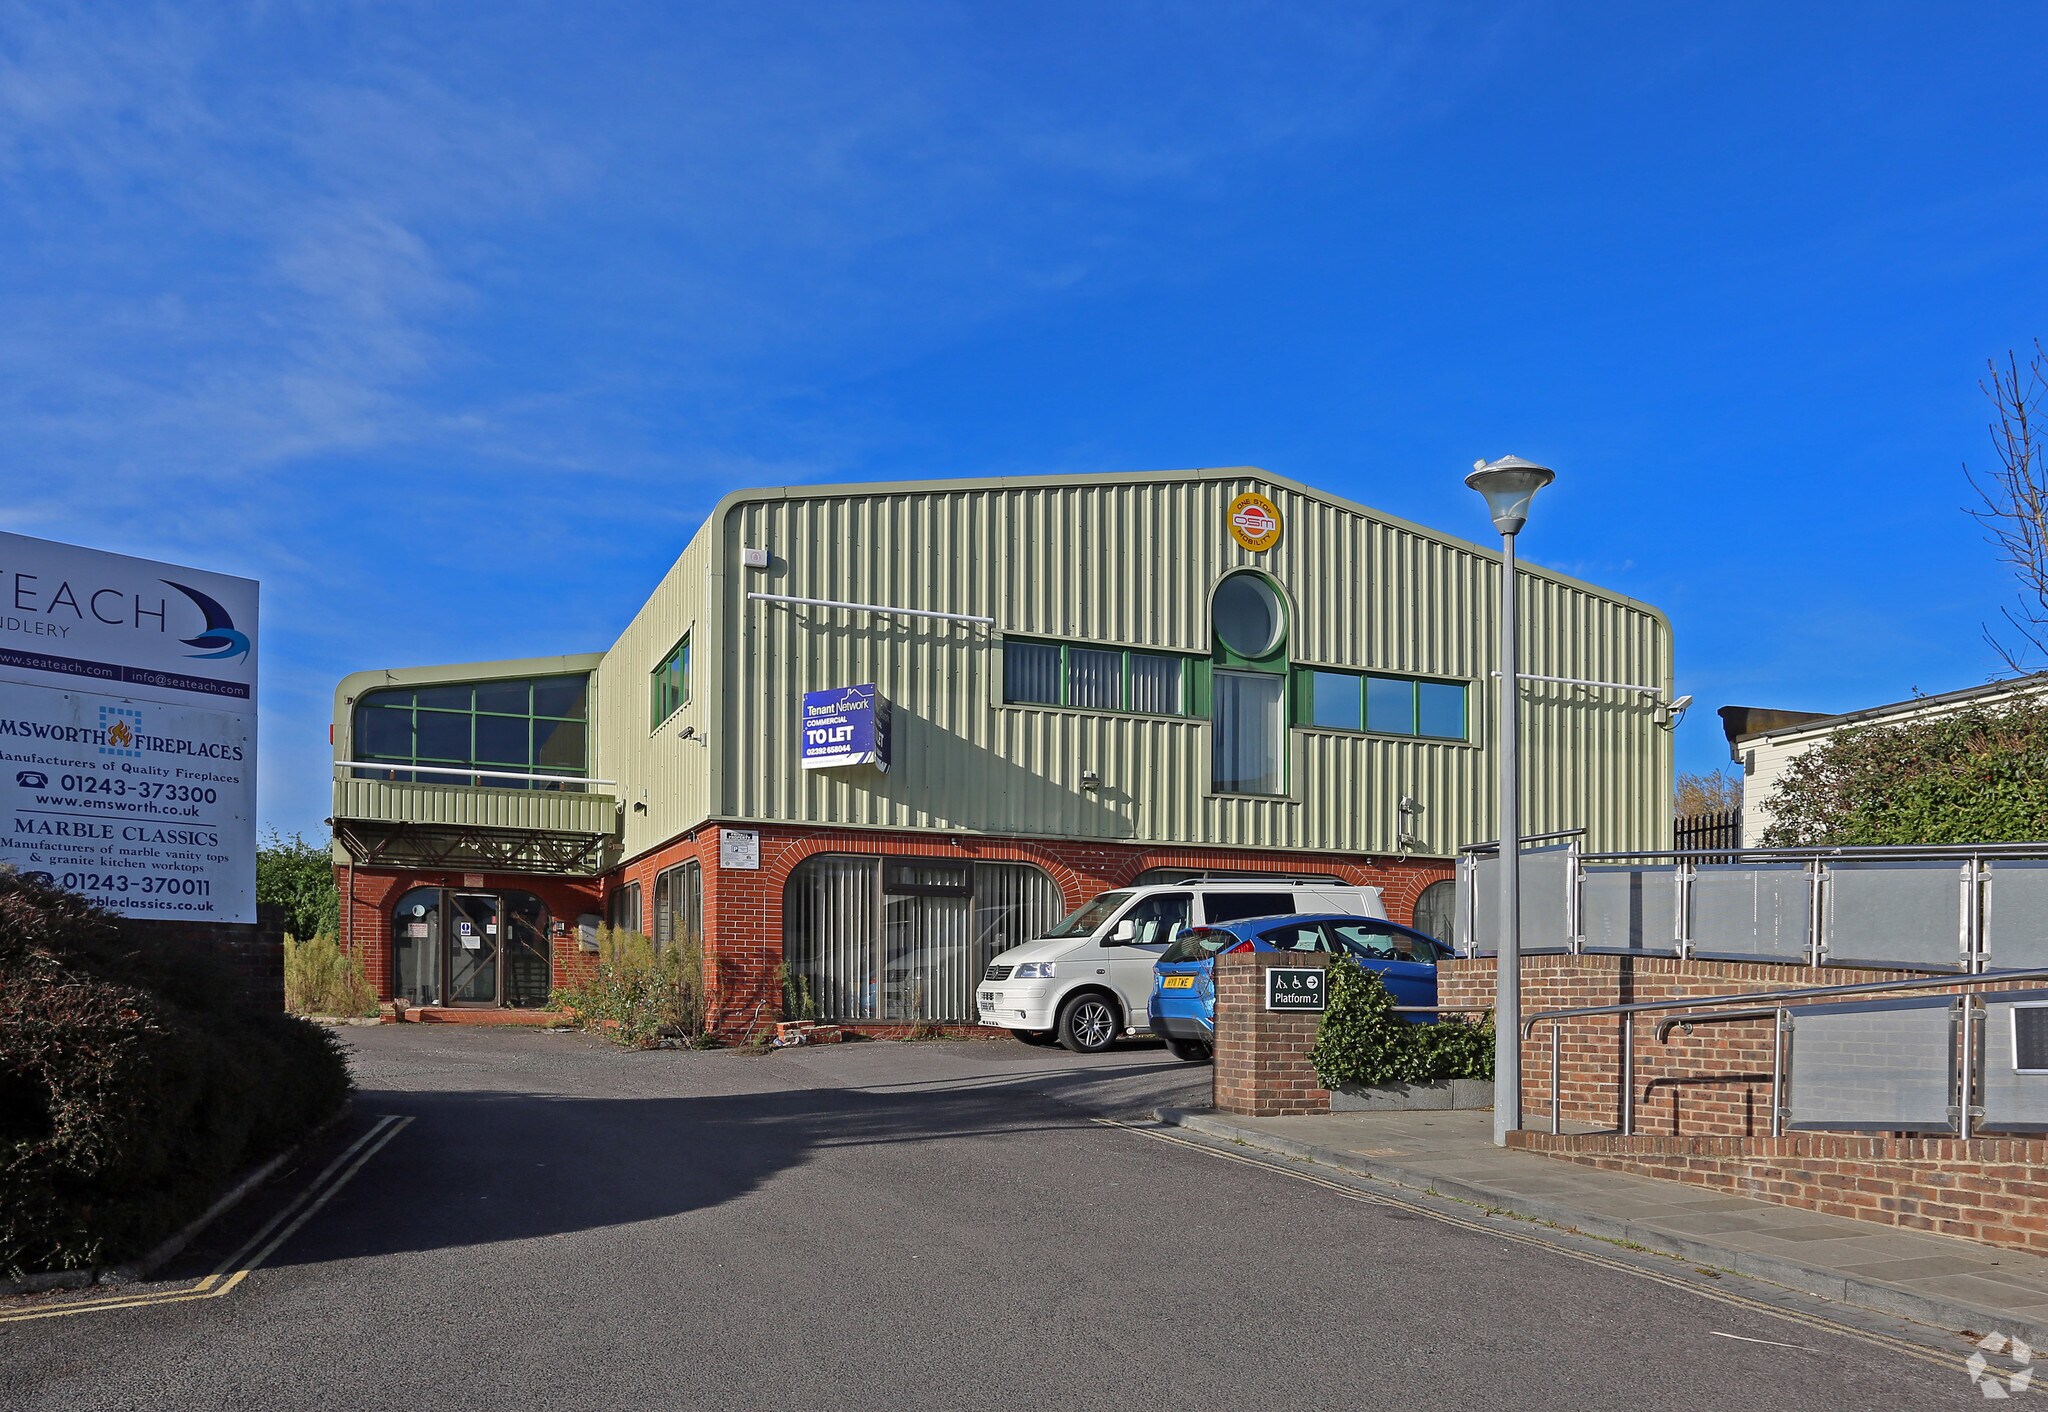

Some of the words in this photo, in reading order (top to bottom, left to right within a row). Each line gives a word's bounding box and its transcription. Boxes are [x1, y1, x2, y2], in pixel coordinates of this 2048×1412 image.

[1237, 499, 1250, 510] ONE
[1253, 499, 1272, 514] STOP
[1237, 530, 1271, 546] MOBILITY
[0, 570, 165, 632] EACH
[132, 670, 244, 695] info@seateach.com
[807, 703, 835, 716] Tenant
[836, 698, 869, 712] Network
[806, 716, 848, 727] COMMERCIAL
[806, 729, 827, 745] TO
[828, 725, 854, 743] LET
[135, 734, 243, 761] FIREPLACES
[0, 750, 96, 769] anufacturers
[102, 761, 115, 770] of
[121, 763, 170, 777] Quality
[175, 768, 240, 784] Fireplaces
[60, 774, 217, 804] 01243-373300
[36, 795, 200, 817] www.emsworth.co.uk
[14, 818, 114, 839] MARBLE
[122, 826, 218, 847] CLASSICS
[0, 837, 95, 853] Manufacturers
[100, 844, 114, 854] of
[119, 847, 161, 858] marble
[165, 850, 202, 861] vanity
[206, 853, 229, 864] tops
[29, 852, 43, 863] &
[49, 855, 95, 866] granite
[100, 857, 146, 869] kitchen
[152, 861, 204, 874] worktops
[63, 872, 210, 896] 01243-370011
[1275, 992, 1312, 1003] Platform
[1312, 993, 1319, 1004] 2
